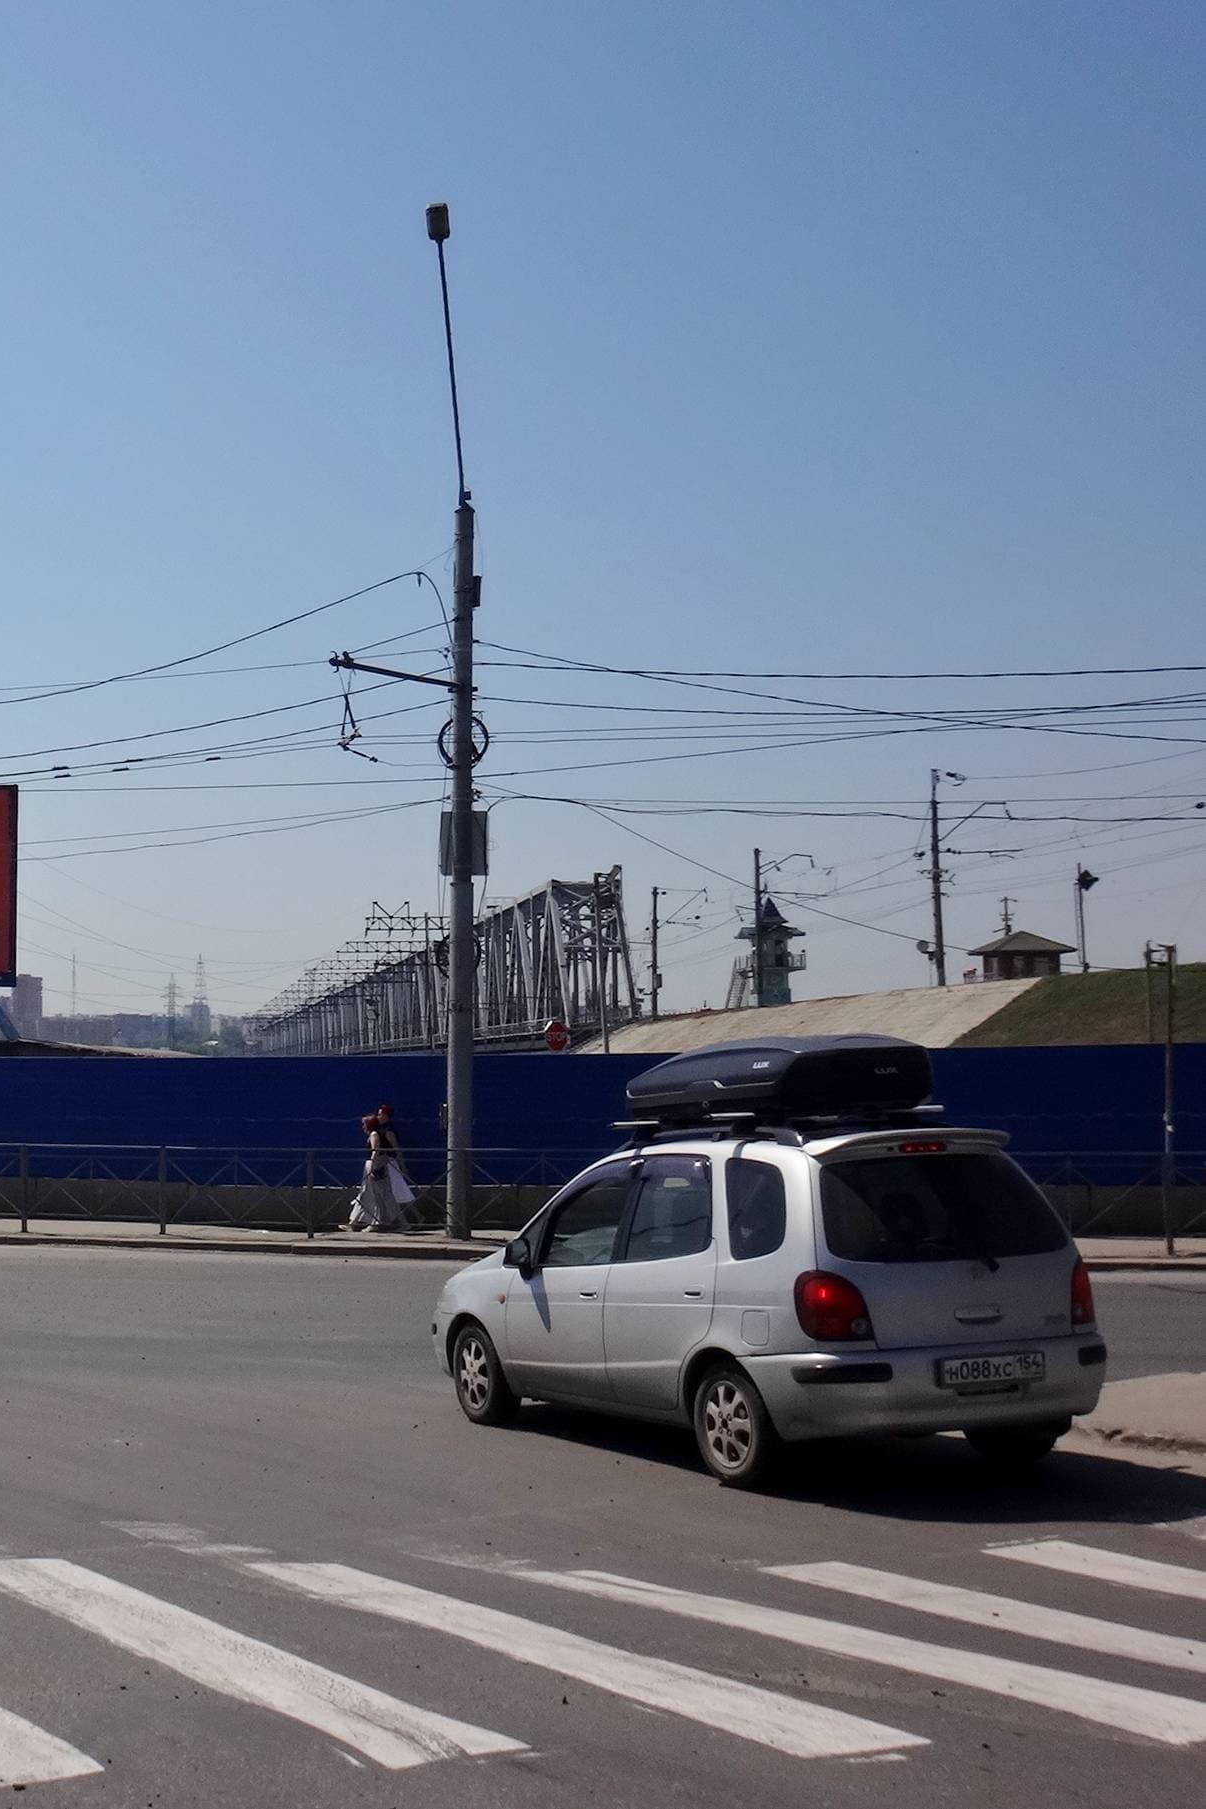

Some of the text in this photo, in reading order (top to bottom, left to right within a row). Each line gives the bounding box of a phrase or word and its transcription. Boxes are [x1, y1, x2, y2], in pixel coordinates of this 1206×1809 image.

[546, 1031, 567, 1041] STOP
[752, 1061, 770, 1069] LUX
[1016, 1355, 1042, 1371] 154
